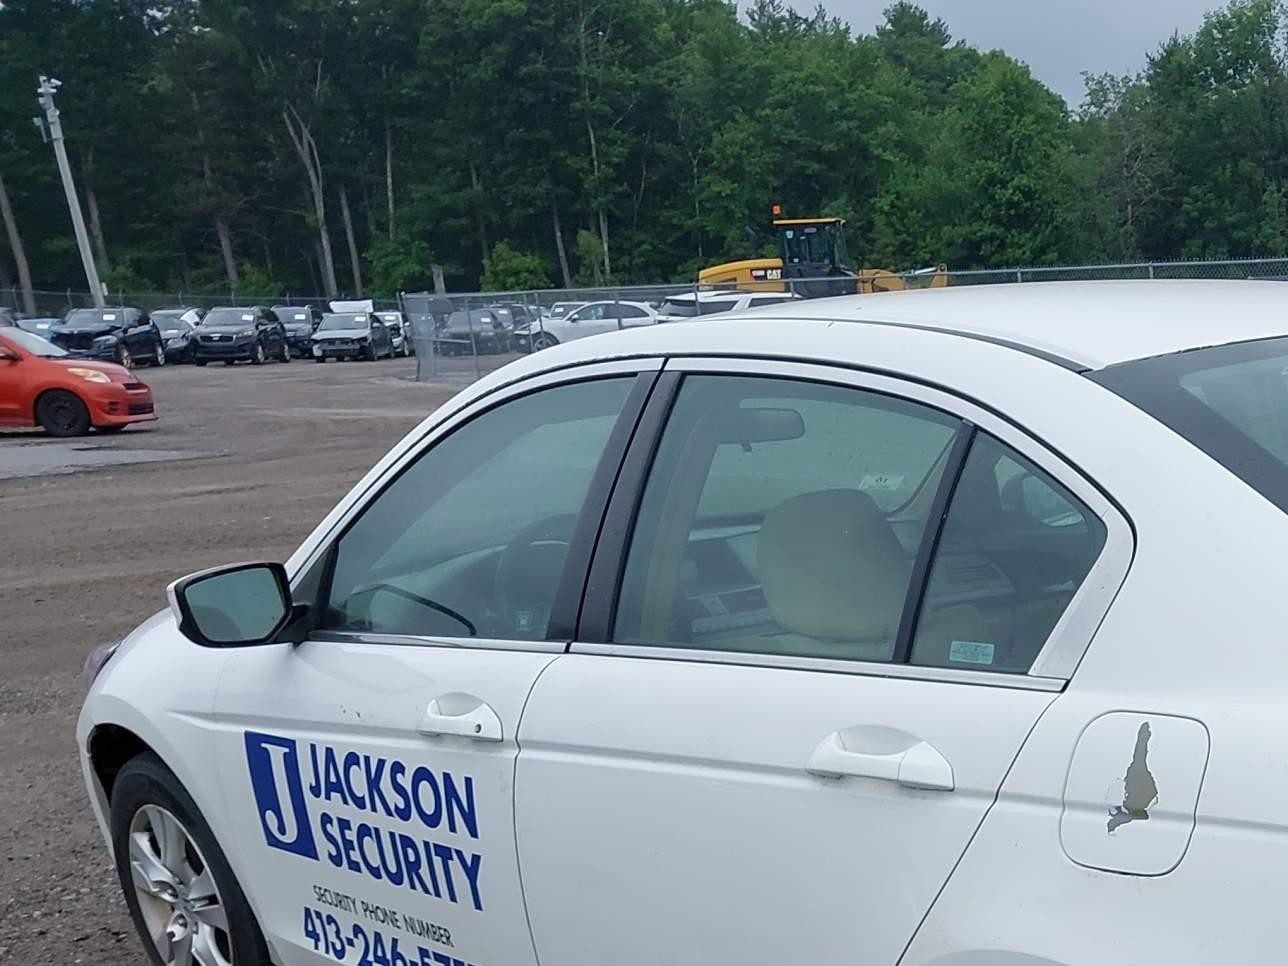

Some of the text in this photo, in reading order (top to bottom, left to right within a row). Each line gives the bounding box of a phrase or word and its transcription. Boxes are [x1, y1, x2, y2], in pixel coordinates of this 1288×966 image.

[766, 269, 782, 280] CAT
[309, 743, 479, 839] JACKSON
[320, 812, 483, 911] SECURITY
[312, 884, 455, 948] SECURITY PHONE NUMBER
